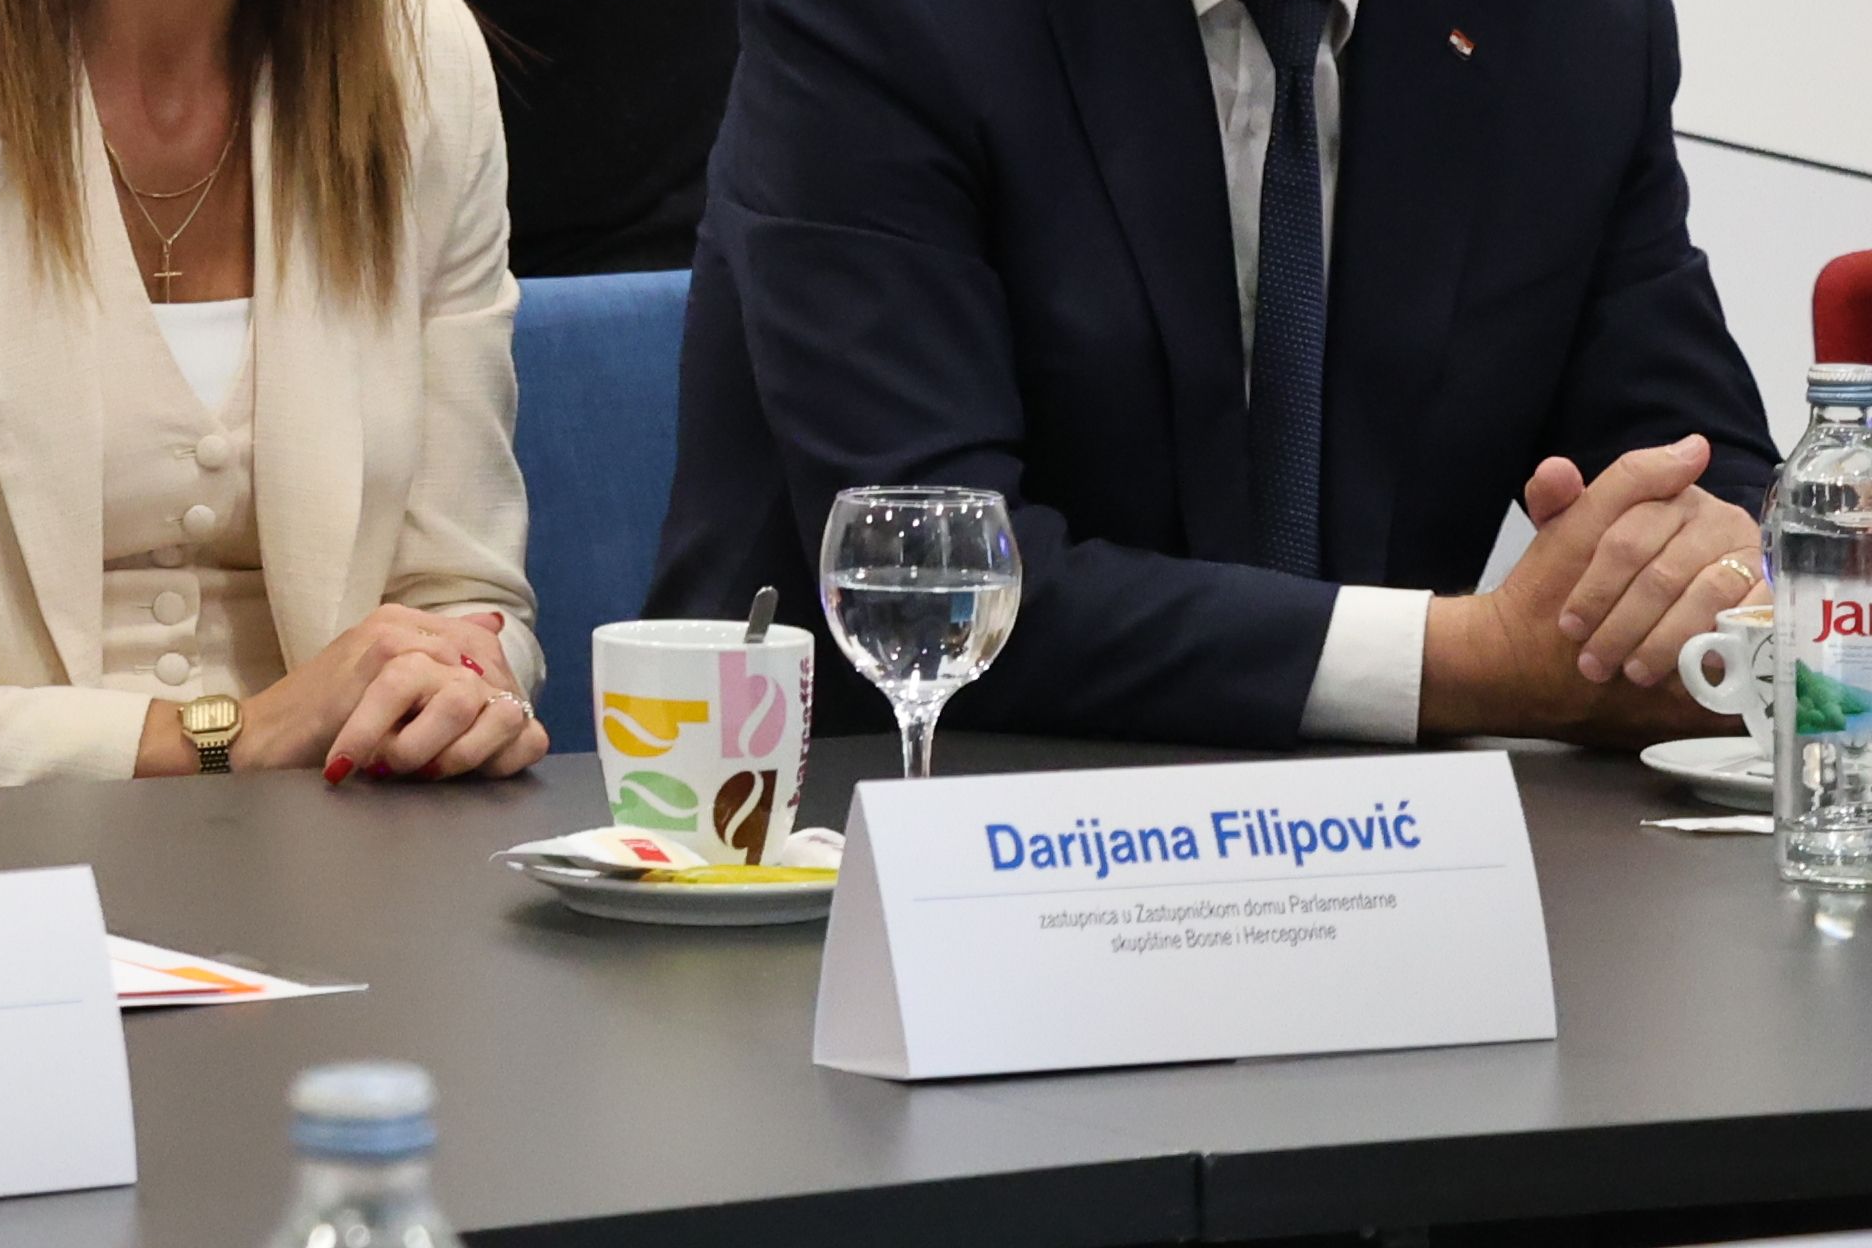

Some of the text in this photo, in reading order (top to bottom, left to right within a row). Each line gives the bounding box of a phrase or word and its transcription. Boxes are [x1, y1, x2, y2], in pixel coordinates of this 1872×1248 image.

[1812, 599, 1872, 643] Ja
[985, 800, 1422, 878] Darijana Filipović
[1038, 892, 1398, 930] zastupnica u Zastupničkom domu Parlamentarne
[1111, 929, 1182, 954] skupštine
[1186, 929, 1233, 948] Bosne
[1243, 923, 1337, 947] Hercegovine
